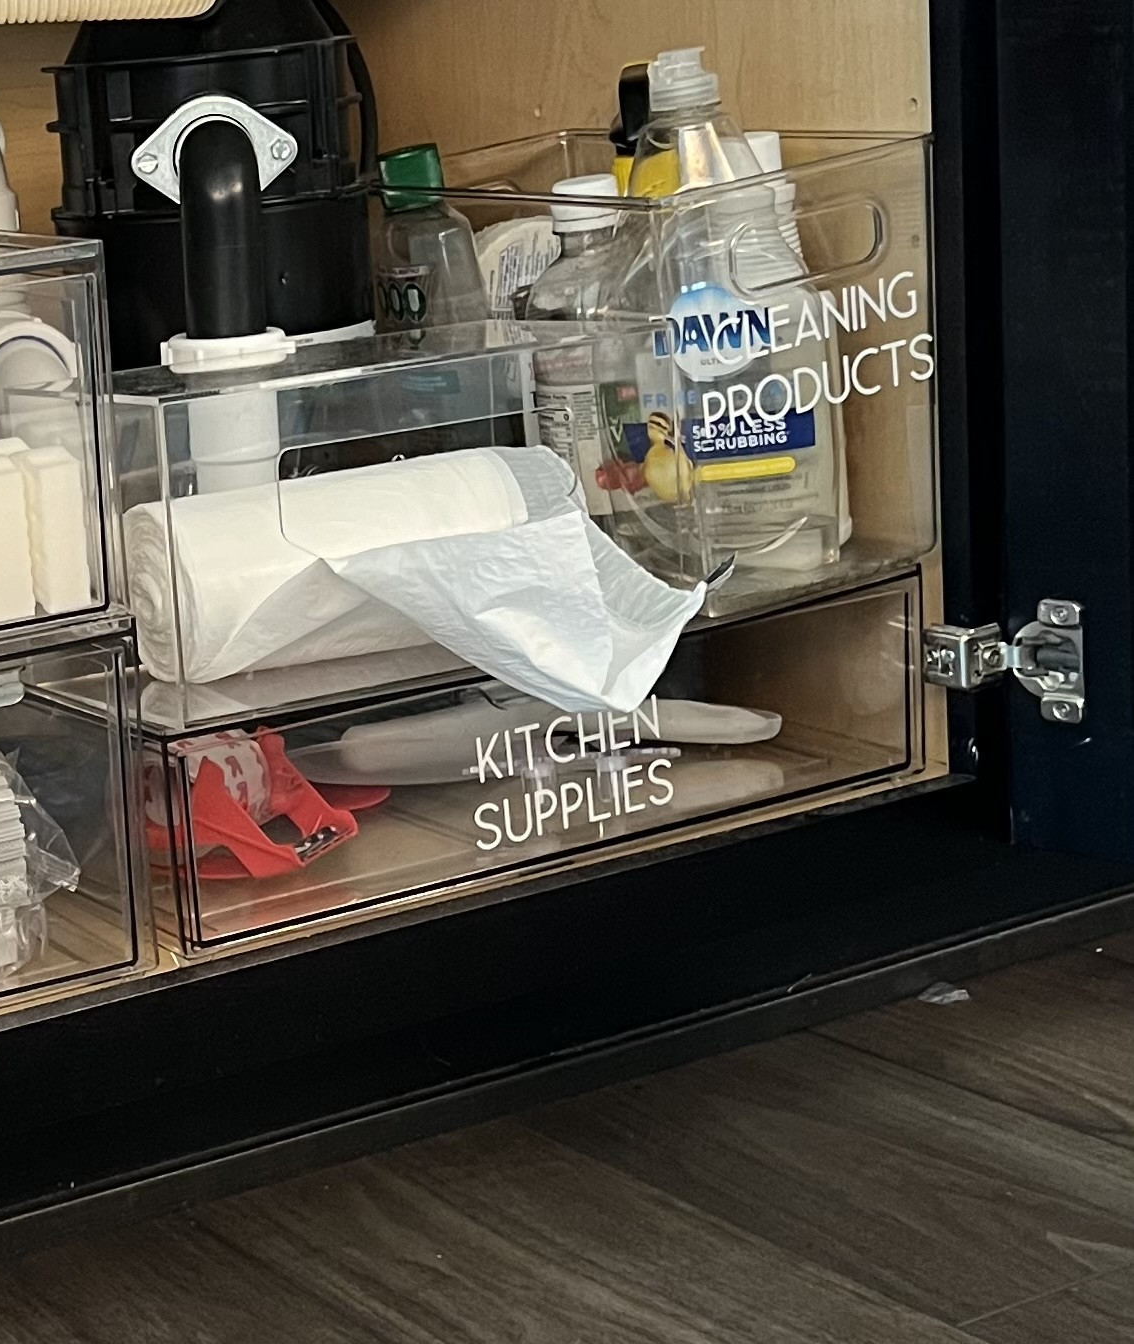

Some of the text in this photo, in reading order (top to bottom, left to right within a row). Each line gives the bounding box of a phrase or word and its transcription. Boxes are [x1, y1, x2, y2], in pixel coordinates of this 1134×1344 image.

[650, 307, 772, 359] DAWN
[712, 272, 917, 366] CLEANING
[702, 334, 934, 439] PRODUCTS
[739, 416, 787, 436] LESS
[693, 432, 789, 453] SCRUBBING
[475, 694, 661, 784] KITCHEN
[473, 758, 674, 851] SUPPLIES
